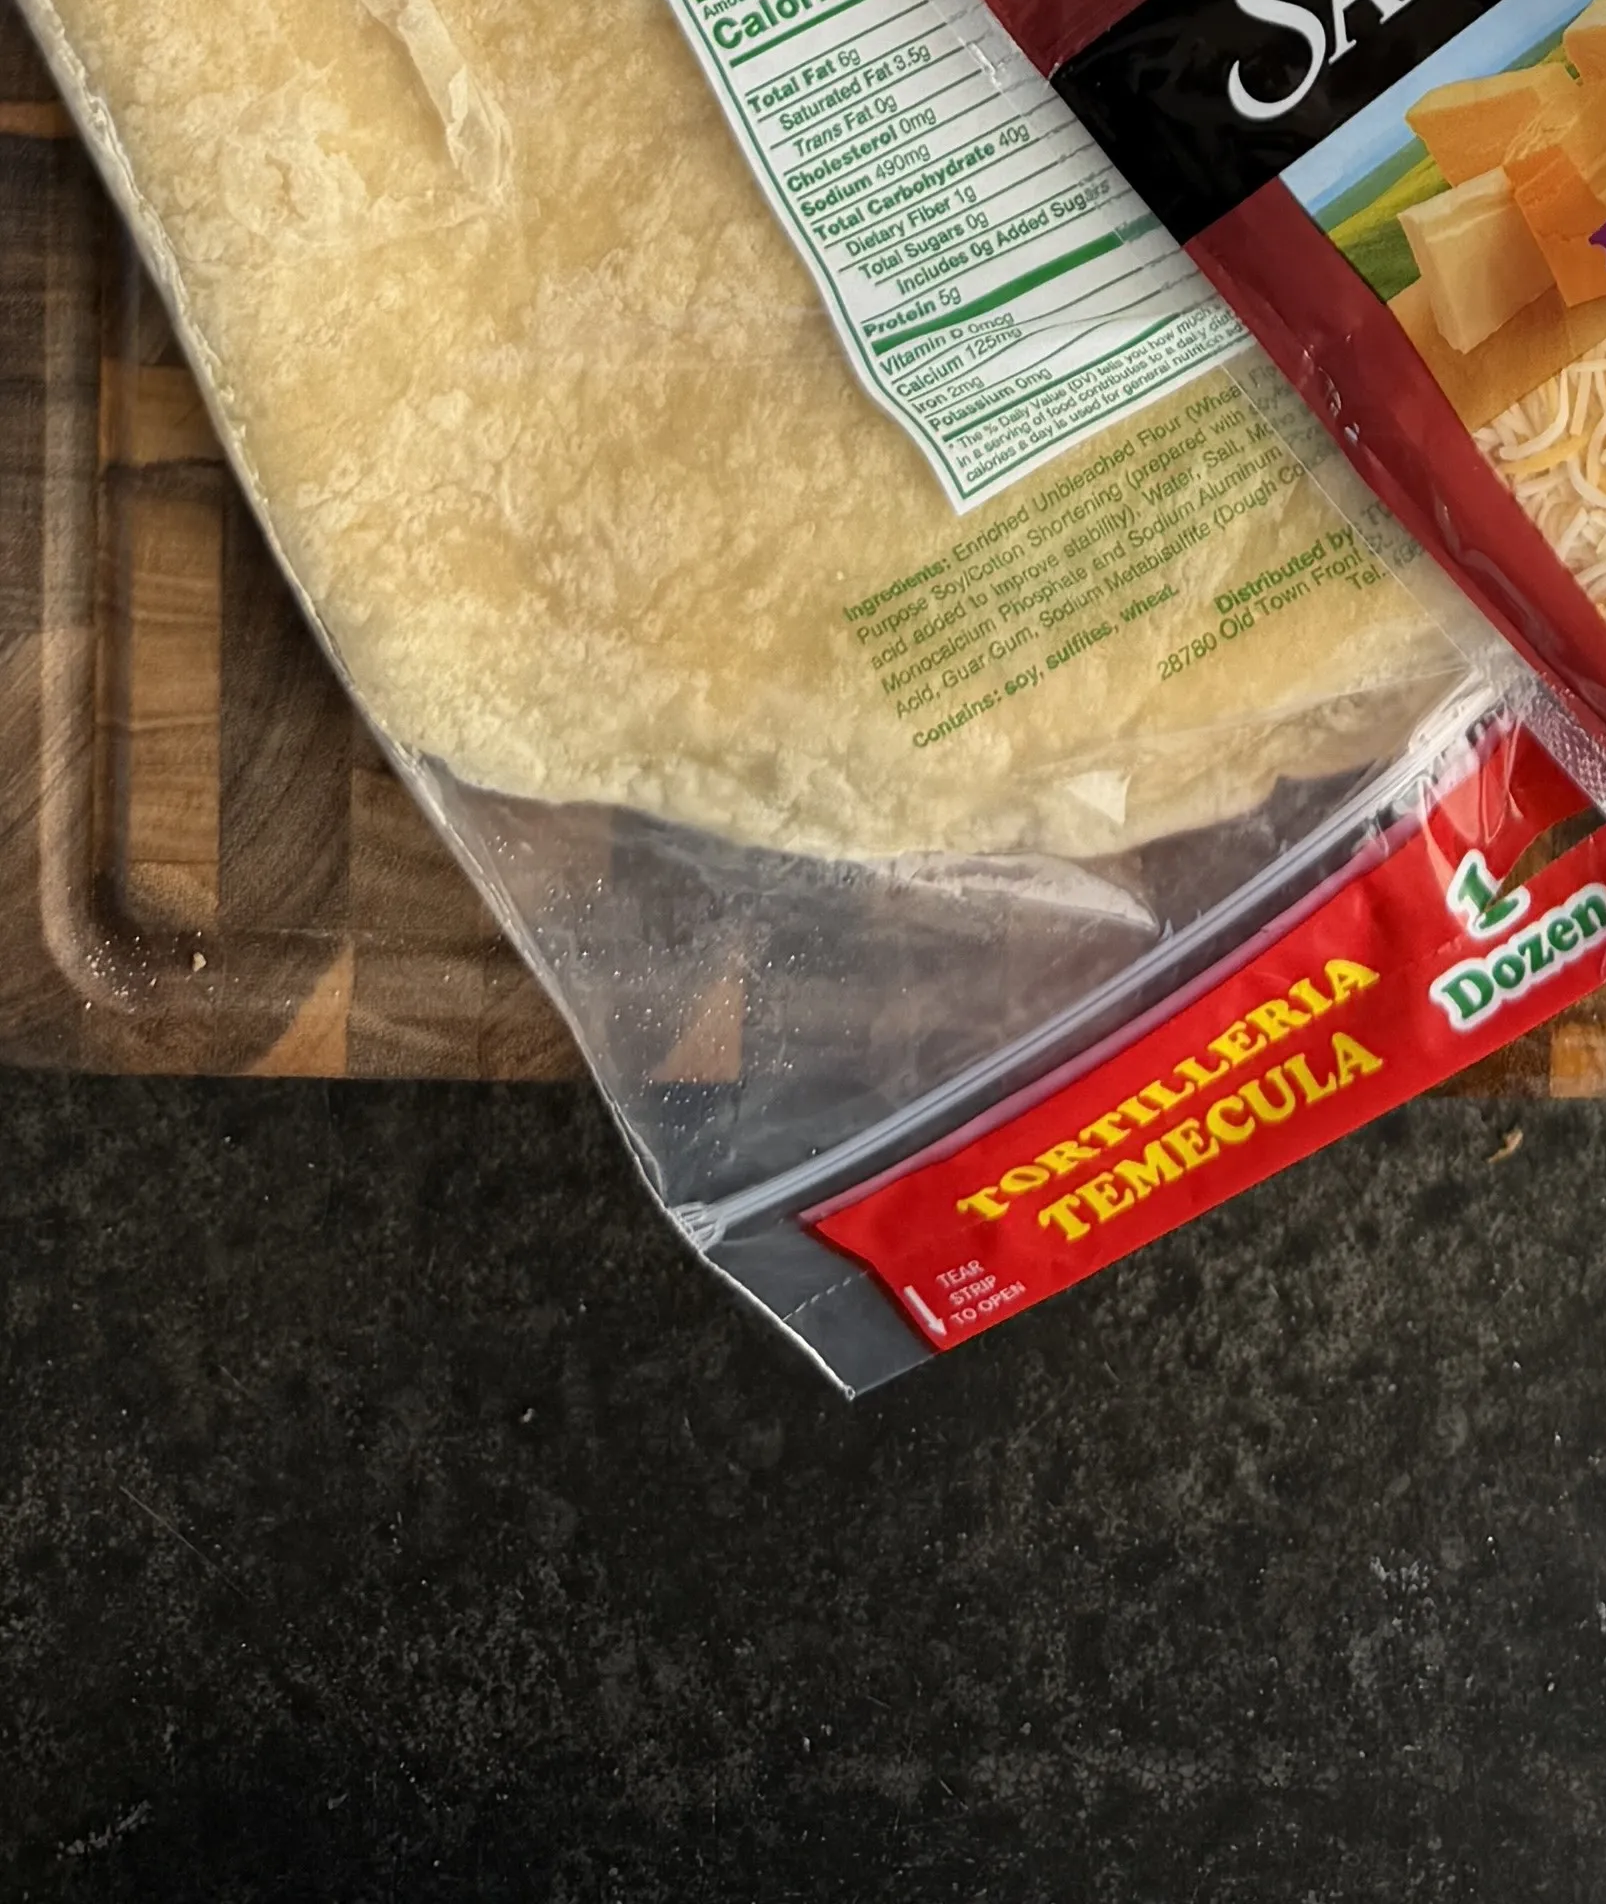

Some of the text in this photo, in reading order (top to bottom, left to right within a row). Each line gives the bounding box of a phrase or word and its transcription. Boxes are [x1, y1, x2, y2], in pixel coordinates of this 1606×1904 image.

[785, 105, 937, 194] Cholesterol 0mg
[799, 141, 932, 219] Sodium 490mg
[812, 121, 1031, 243] Total Carbohydrate 40g
[861, 284, 963, 341] Protein 5g
[910, 579, 1179, 750] Contains: soy, sulfites, wheat.
[1458, 862, 1519, 929] 1
[956, 960, 1379, 1221] TORTILLERIA
[1035, 1029, 1383, 1242] TEMECULA
[935, 1257, 984, 1288] TEAR
[947, 1274, 996, 1307] STRIP
[949, 1279, 1026, 1325] TO OPEN
